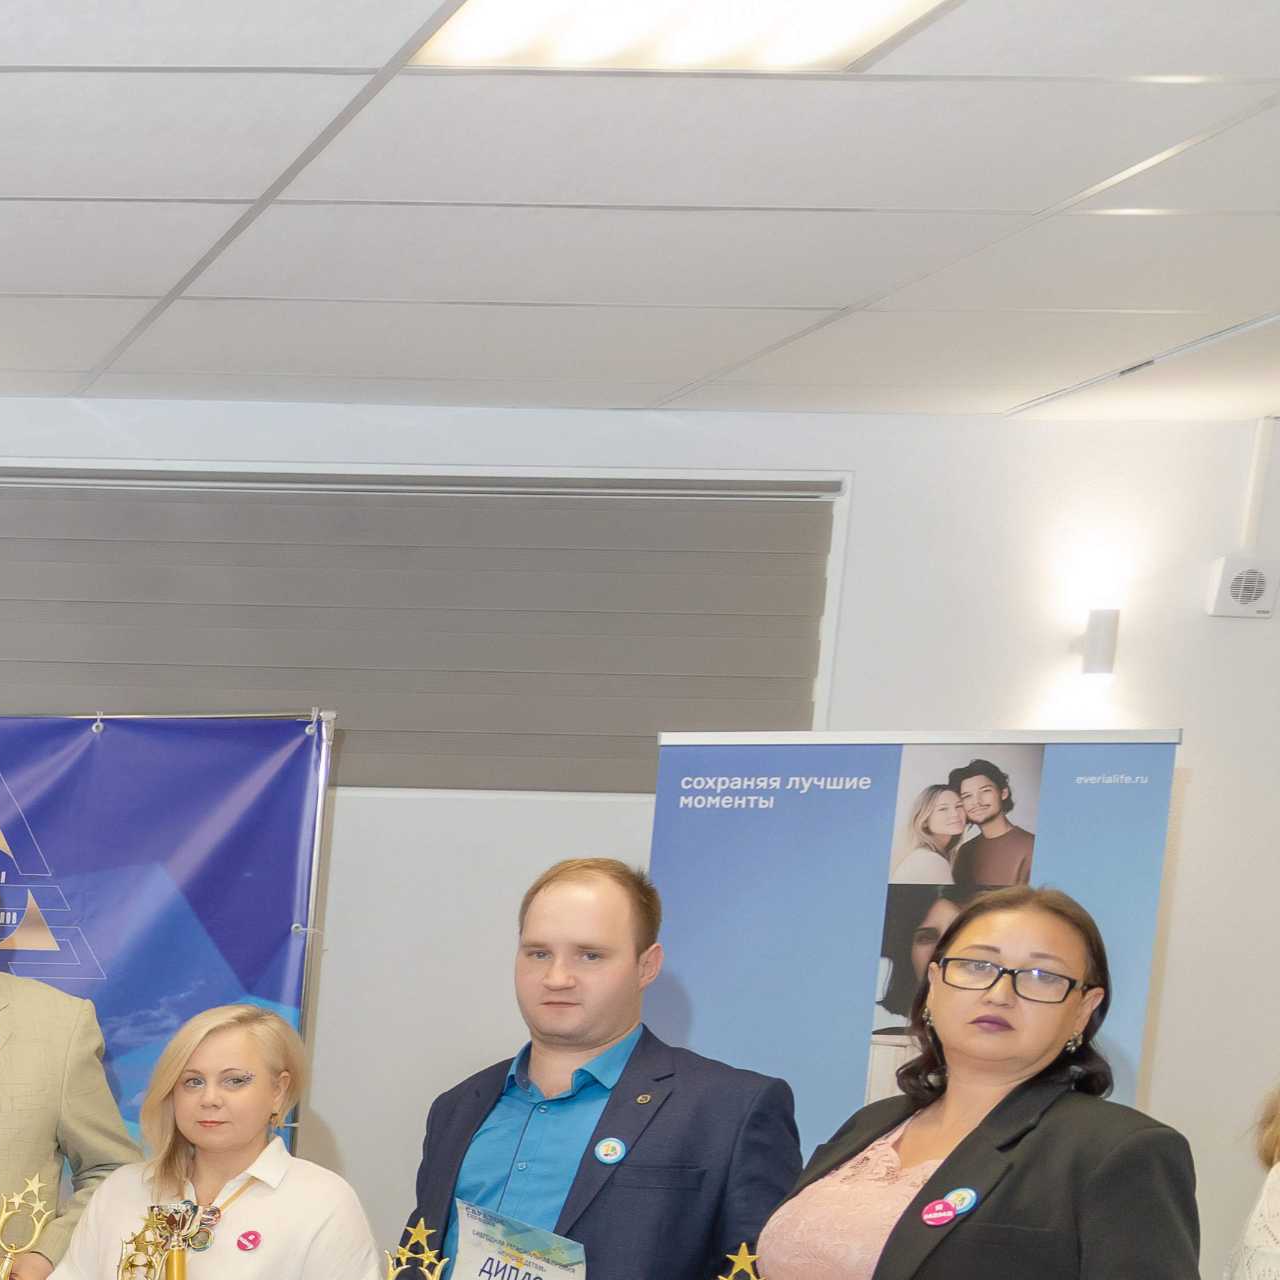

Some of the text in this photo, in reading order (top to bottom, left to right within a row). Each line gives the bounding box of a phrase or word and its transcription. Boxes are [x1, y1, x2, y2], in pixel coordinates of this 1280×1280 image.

[680, 776, 872, 794] сохраняя лучшие
[679, 795, 775, 809] моменты
